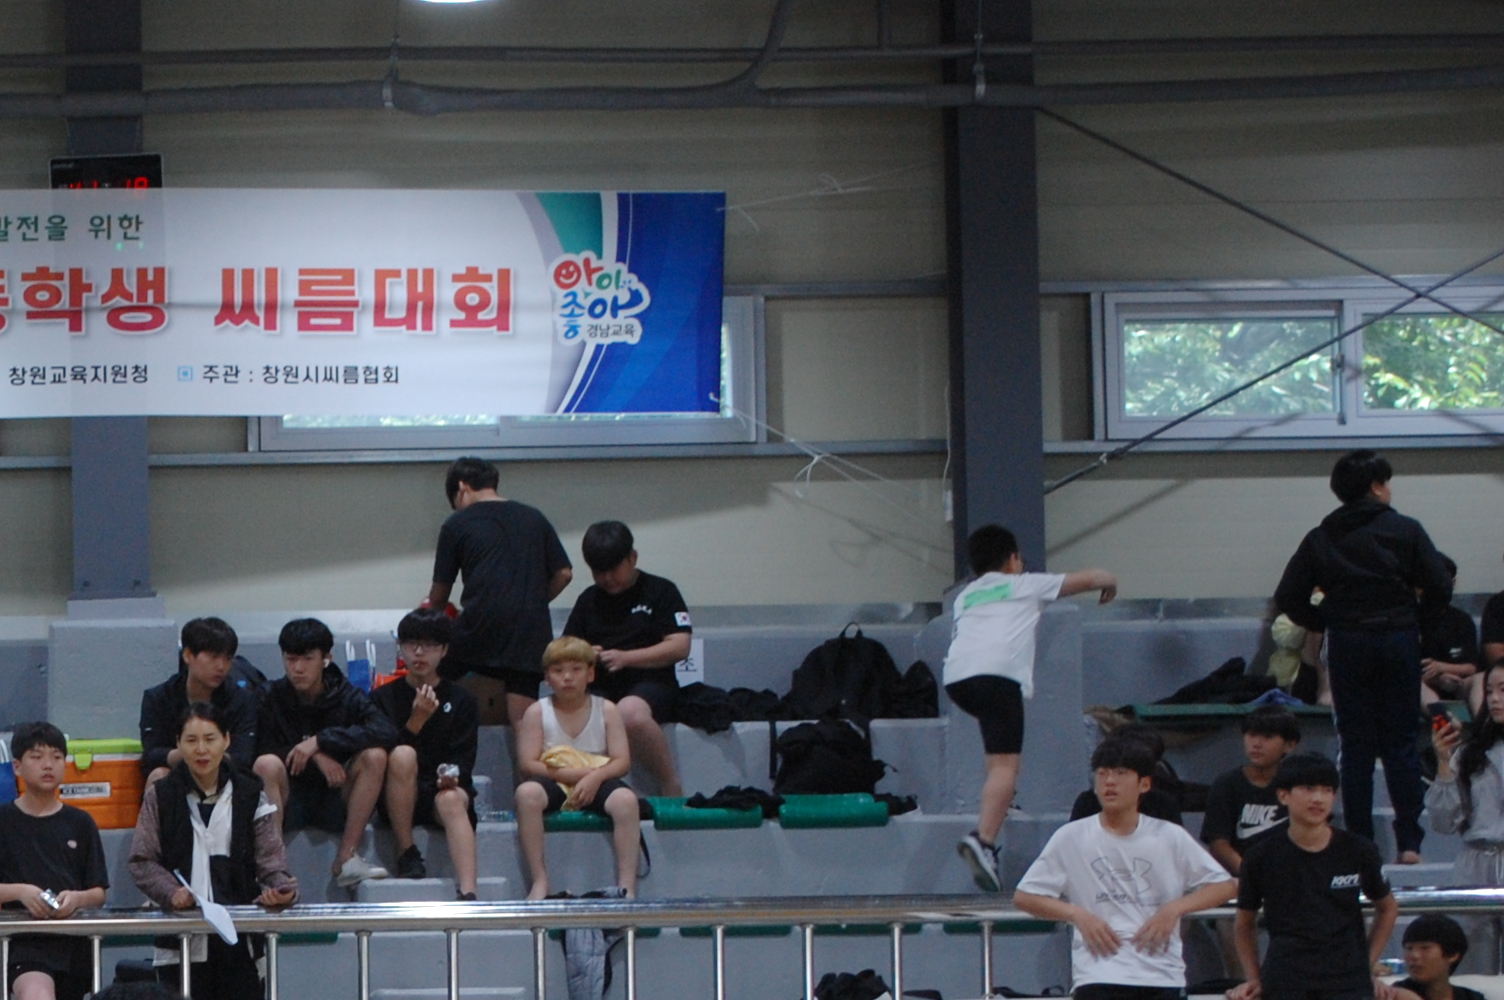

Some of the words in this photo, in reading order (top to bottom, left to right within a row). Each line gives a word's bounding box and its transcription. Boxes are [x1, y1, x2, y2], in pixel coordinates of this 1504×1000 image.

[88, 213, 144, 241] 위한
[215, 266, 511, 332] 씨름대회
[587, 323, 635, 338] 경남교육
[9, 363, 148, 386] 창원교육지원청
[202, 364, 241, 384] 주관
[262, 364, 399, 385] 창원시씨름협회
[1240, 803, 1279, 825] NIKE
